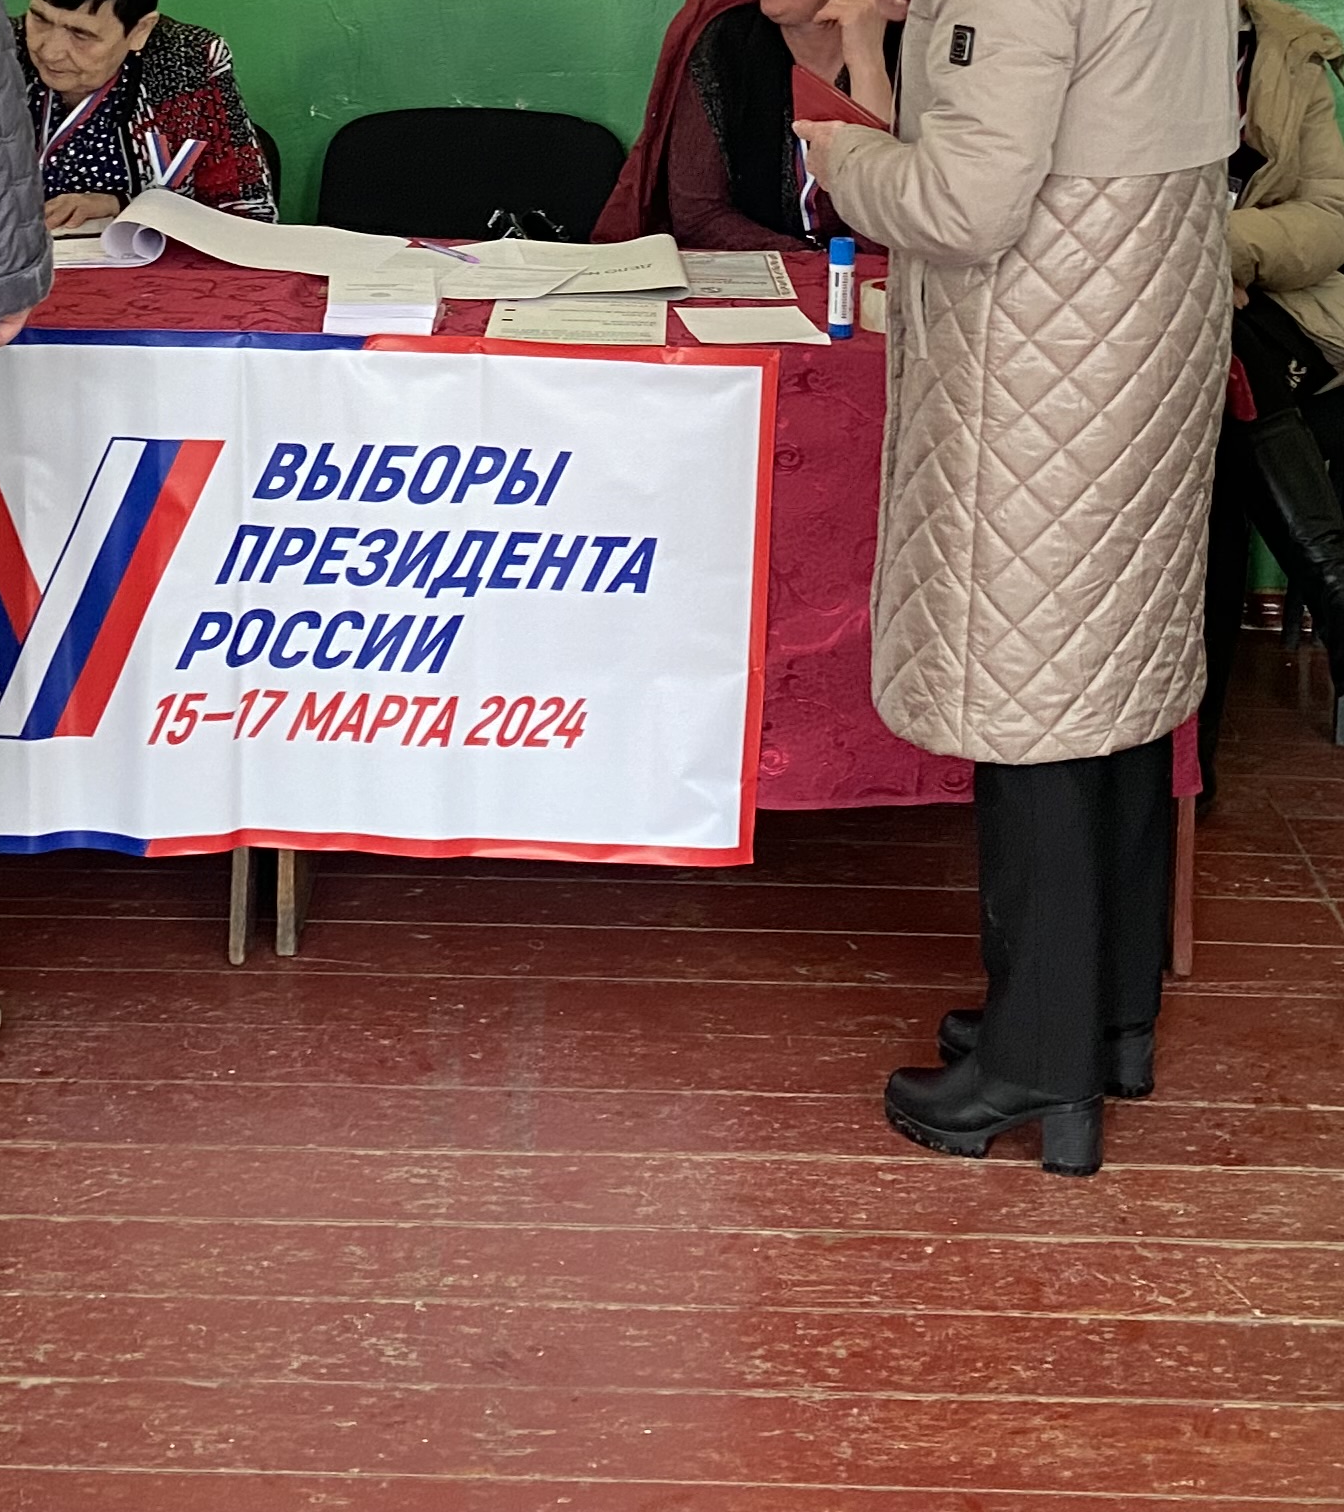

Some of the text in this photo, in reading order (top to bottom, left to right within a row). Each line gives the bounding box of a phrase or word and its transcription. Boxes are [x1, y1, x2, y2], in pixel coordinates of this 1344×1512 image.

[251, 441, 572, 508] ВЫБОРЫ
[214, 523, 659, 599] ПРЕЗИДЕНТА
[175, 609, 465, 675] РОССИИ
[290, 691, 458, 748] МАРТА
[463, 694, 589, 750] 2024
